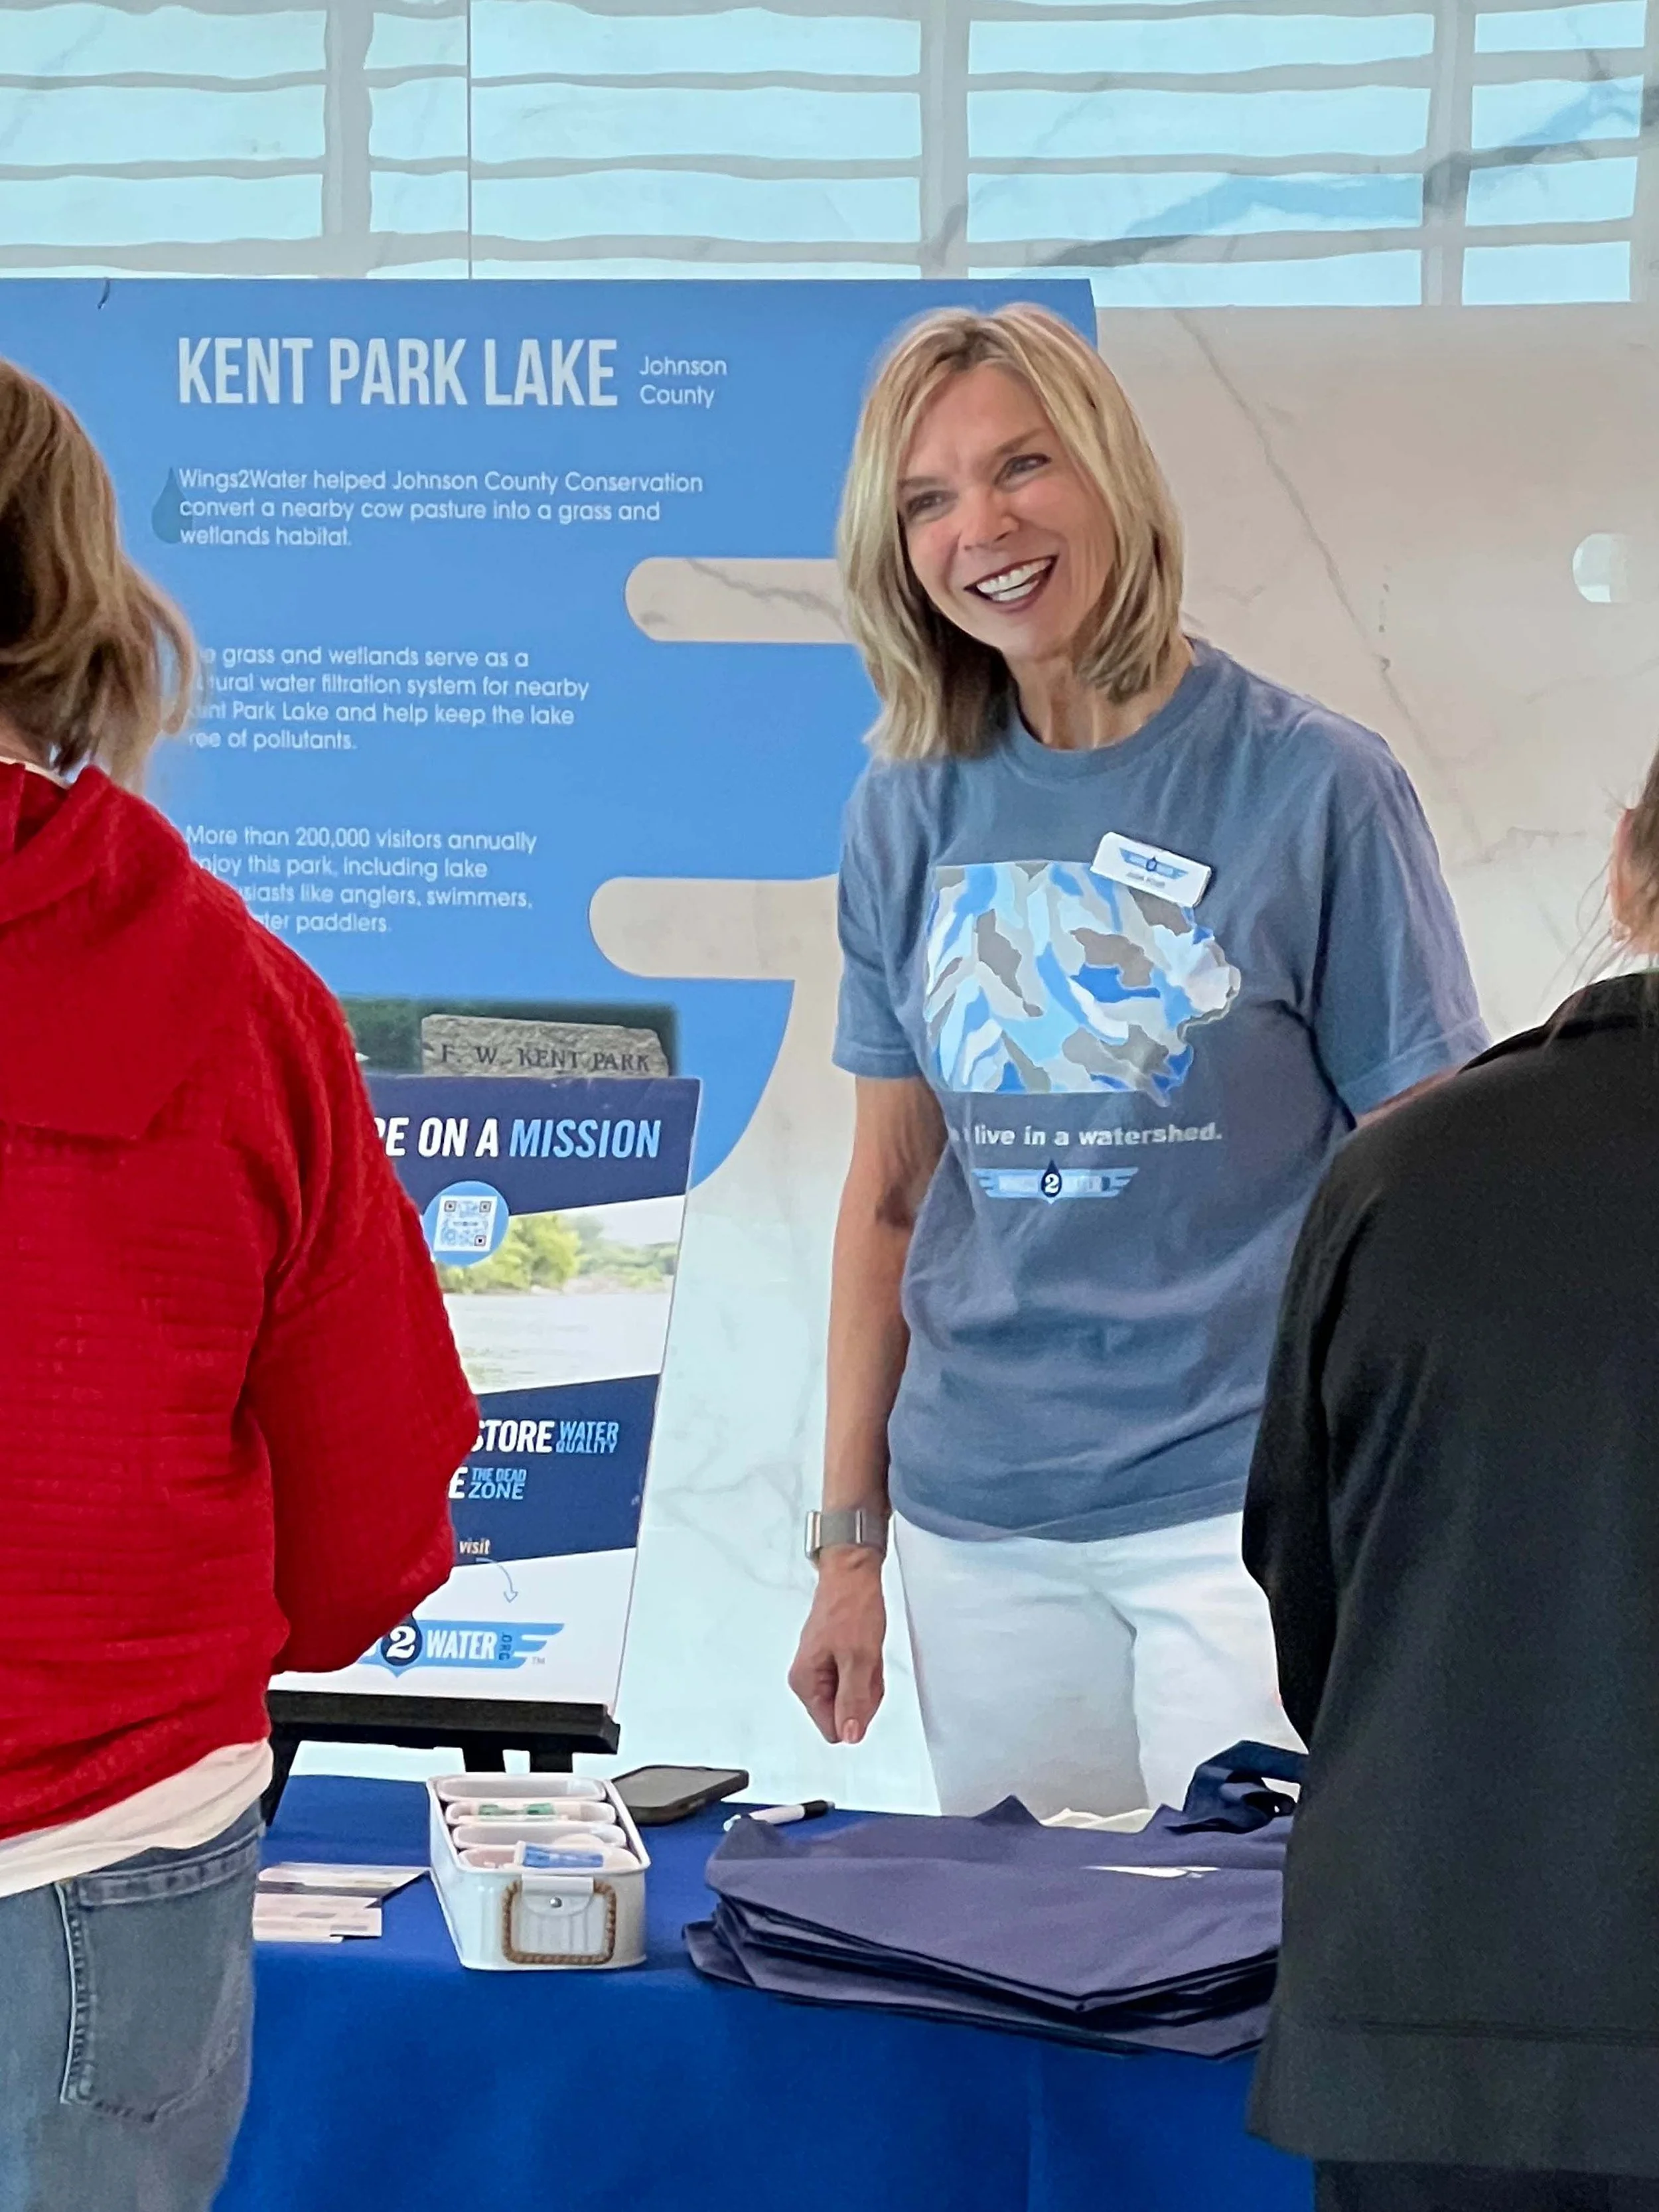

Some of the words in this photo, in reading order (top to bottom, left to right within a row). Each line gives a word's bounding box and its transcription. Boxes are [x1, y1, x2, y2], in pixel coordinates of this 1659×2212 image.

[179, 338, 313, 404] KENT
[330, 338, 467, 405] PARK
[484, 339, 617, 406] LAKE
[640, 356, 727, 376] Johnson
[640, 385, 715, 409] County
[179, 469, 307, 493] Wings2Water
[314, 470, 386, 493] helped
[393, 471, 477, 490] Johnson
[485, 471, 559, 495] County
[565, 471, 703, 492] Conservation
[180, 499, 254, 516] convert
[262, 502, 275, 516] a
[282, 500, 354, 521] nearby
[362, 502, 403, 518] cow
[410, 500, 486, 522] pasture
[493, 500, 530, 519] into
[538, 504, 551, 520] a
[559, 504, 611, 525] grass
[618, 502, 660, 521] and
[180, 526, 269, 546] wetlands
[276, 527, 352, 546] habitat.
[223, 648, 274, 668] grass
[281, 646, 321, 664] and
[328, 646, 419, 666] wetlands
[425, 651, 478, 666] serve
[485, 652, 508, 667] as
[515, 652, 528, 667] a
[260, 674, 316, 692] water
[322, 673, 400, 694] filtration
[407, 675, 476, 698] system
[482, 676, 508, 695] for
[516, 677, 589, 701] nearby
[233, 700, 275, 719] Park
[283, 701, 329, 720] Lake
[336, 703, 376, 721] and
[384, 703, 427, 725] help
[435, 704, 485, 727] keep
[492, 705, 524, 723] the
[532, 705, 574, 724] lake
[228, 729, 247, 747] of
[253, 729, 357, 751] pollutants.
[186, 826, 237, 844] More
[245, 826, 289, 846] than
[296, 827, 370, 848] 200,000
[377, 828, 441, 849] visitors
[449, 831, 537, 854] annually
[249, 855, 280, 874] this
[287, 855, 338, 877] park,
[344, 857, 437, 882] including
[445, 857, 487, 878] lake
[301, 883, 333, 902] like
[340, 885, 421, 909] anglers,
[427, 887, 532, 909] swimmers,
[518, 1048, 585, 1069] KENT
[593, 1052, 650, 1071] PARK
[417, 1117, 469, 1157] ON
[474, 1118, 498, 1157] A
[509, 1119, 661, 1158] MISSION
[974, 1125, 1015, 1145] live
[1023, 1126, 1046, 1145] in
[1054, 1130, 1069, 1146] a
[1079, 1122, 1222, 1146] watershed.
[1044, 1174, 1060, 1195] 2
[559, 1420, 618, 1441] WATER
[555, 1438, 618, 1454] QUALITY
[472, 1467, 492, 1481] THE
[496, 1468, 526, 1482] DEAD
[468, 1482, 525, 1500] ZONE
[459, 1538, 491, 1555] visit
[386, 1626, 416, 1659] 2
[427, 1629, 498, 1660] WATER
